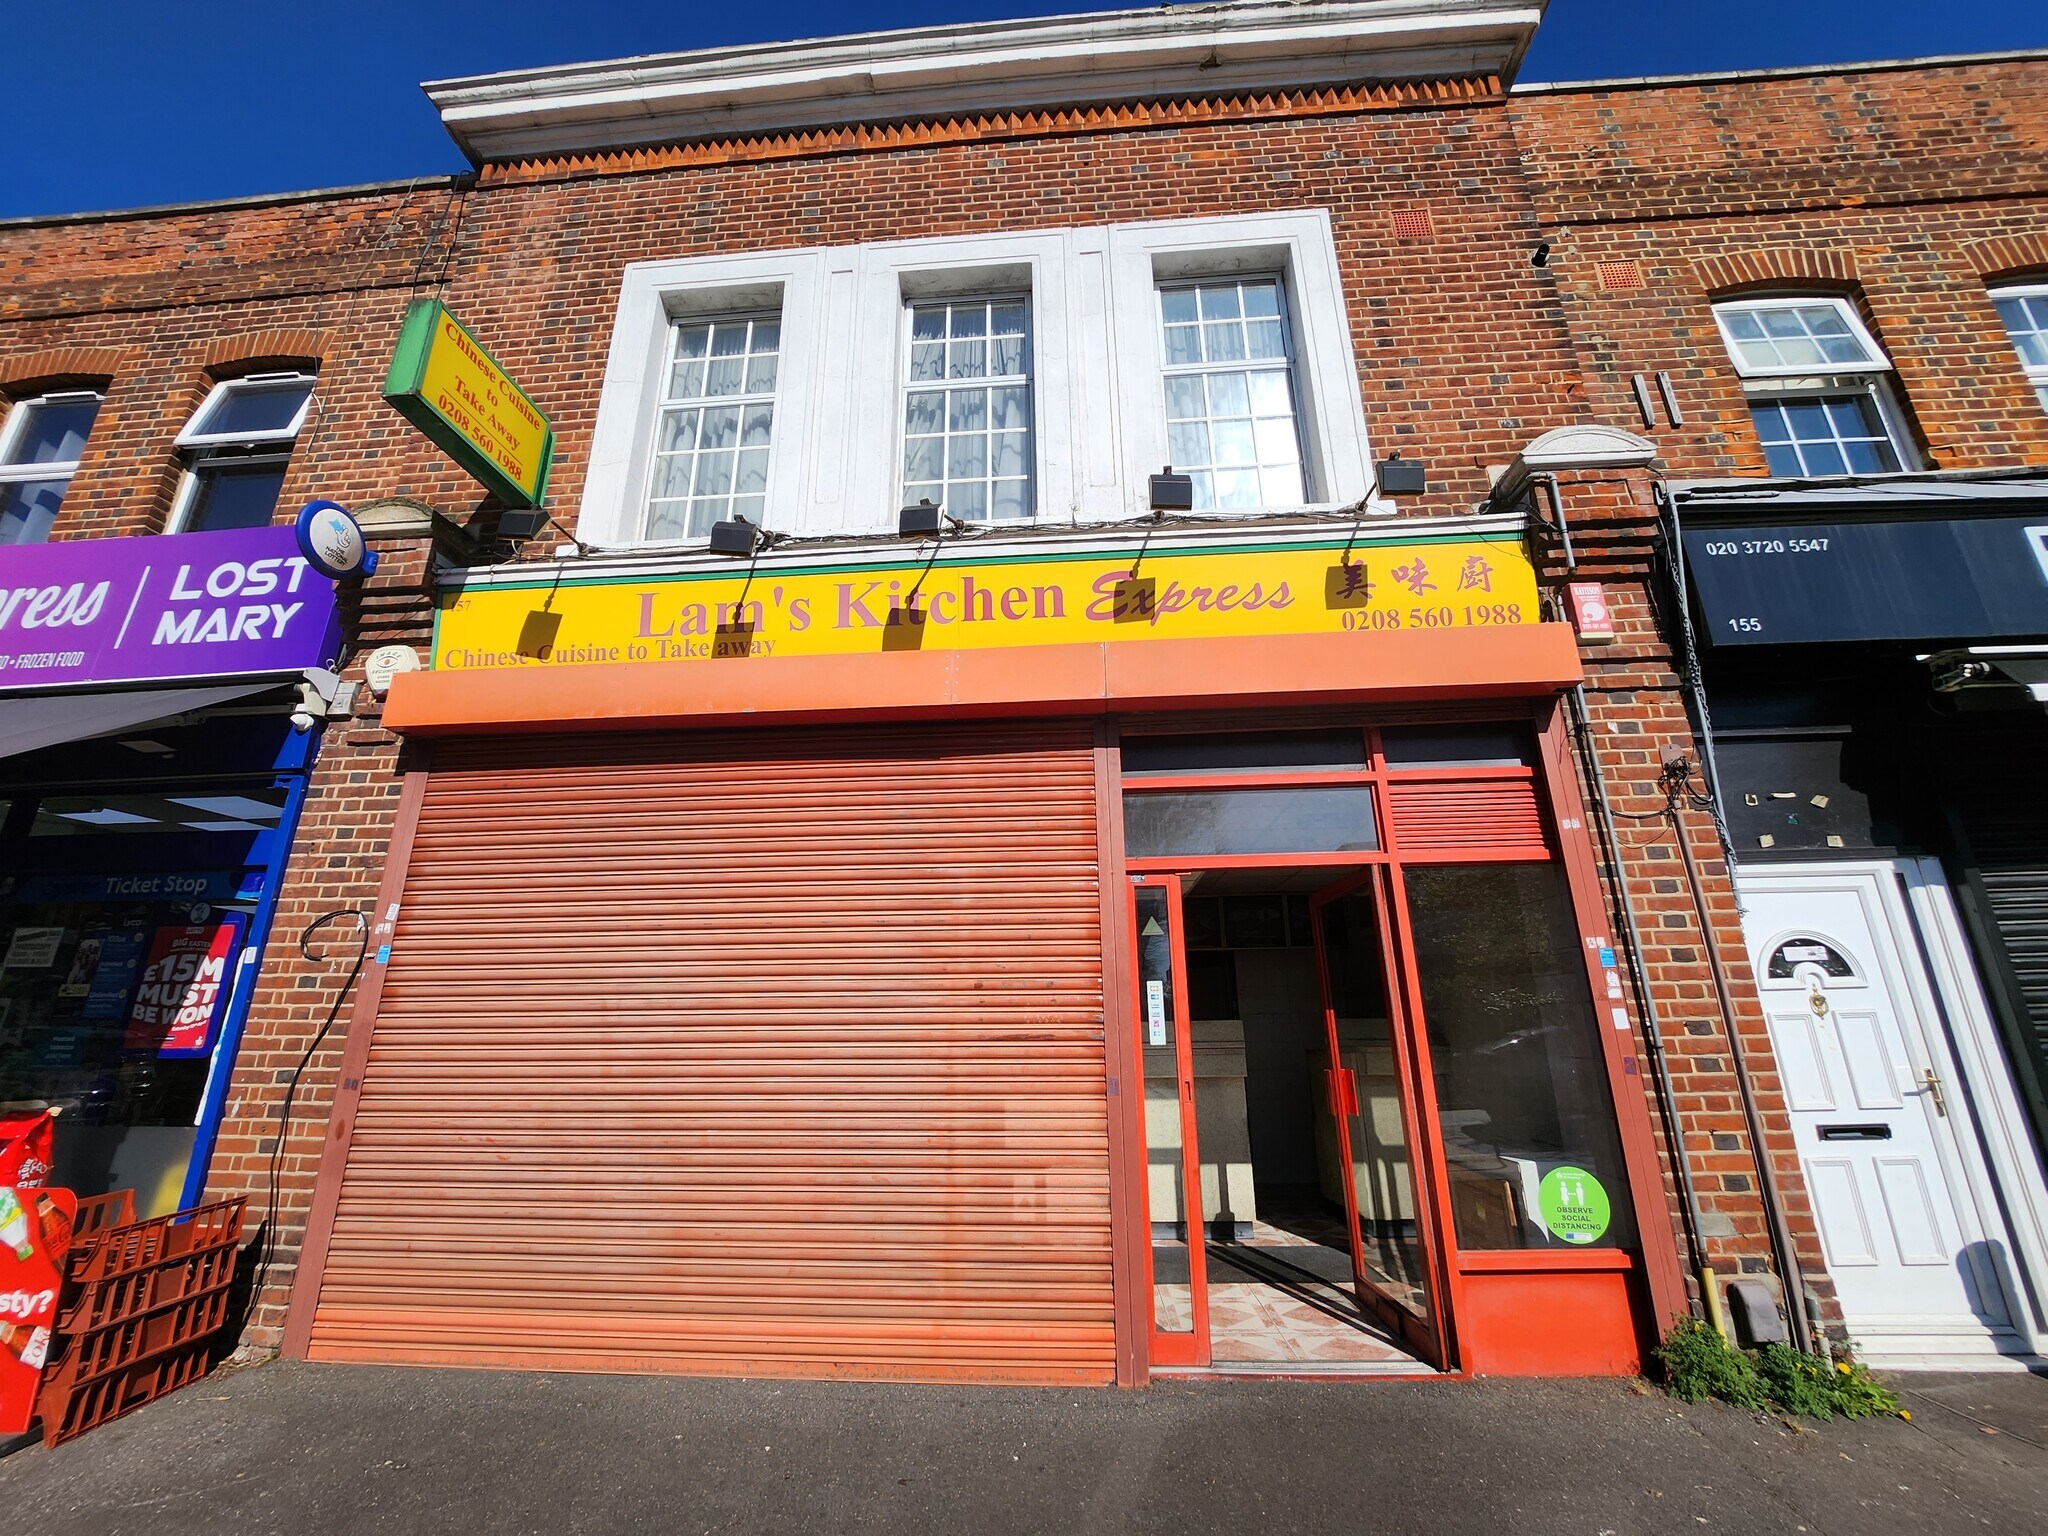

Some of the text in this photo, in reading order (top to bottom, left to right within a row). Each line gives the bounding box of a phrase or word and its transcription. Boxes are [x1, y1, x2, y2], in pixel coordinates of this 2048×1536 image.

[445, 322, 541, 431] Chinese Cuisine
[486, 389, 498, 407] to
[455, 375, 521, 451] Take Away
[438, 394, 522, 481] 0208 560 1988
[1706, 538, 1829, 556] 020 3720 5547
[169, 556, 309, 601] LOST
[0, 580, 110, 629] ress
[633, 570, 1296, 638] Lam's Kitchen Express
[151, 602, 304, 645] MARY
[1342, 604, 1522, 631] 0208 560 1988
[1728, 617, 1762, 632] 155
[14, 653, 56, 669] FROZEN
[55, 651, 85, 667] FOOD
[444, 638, 776, 668] Chinese Cuisine to Take away
[106, 875, 208, 895] Ticket Stop
[172, 938, 188, 947] BIG
[143, 953, 225, 982] £15M
[135, 983, 220, 1006] MUST
[131, 1003, 159, 1025] BE
[161, 1003, 215, 1026] WON
[1557, 1206, 1594, 1214] OBSERVE
[1562, 1214, 1591, 1222] SOCIAL
[1552, 1222, 1602, 1230] DISTANCING
